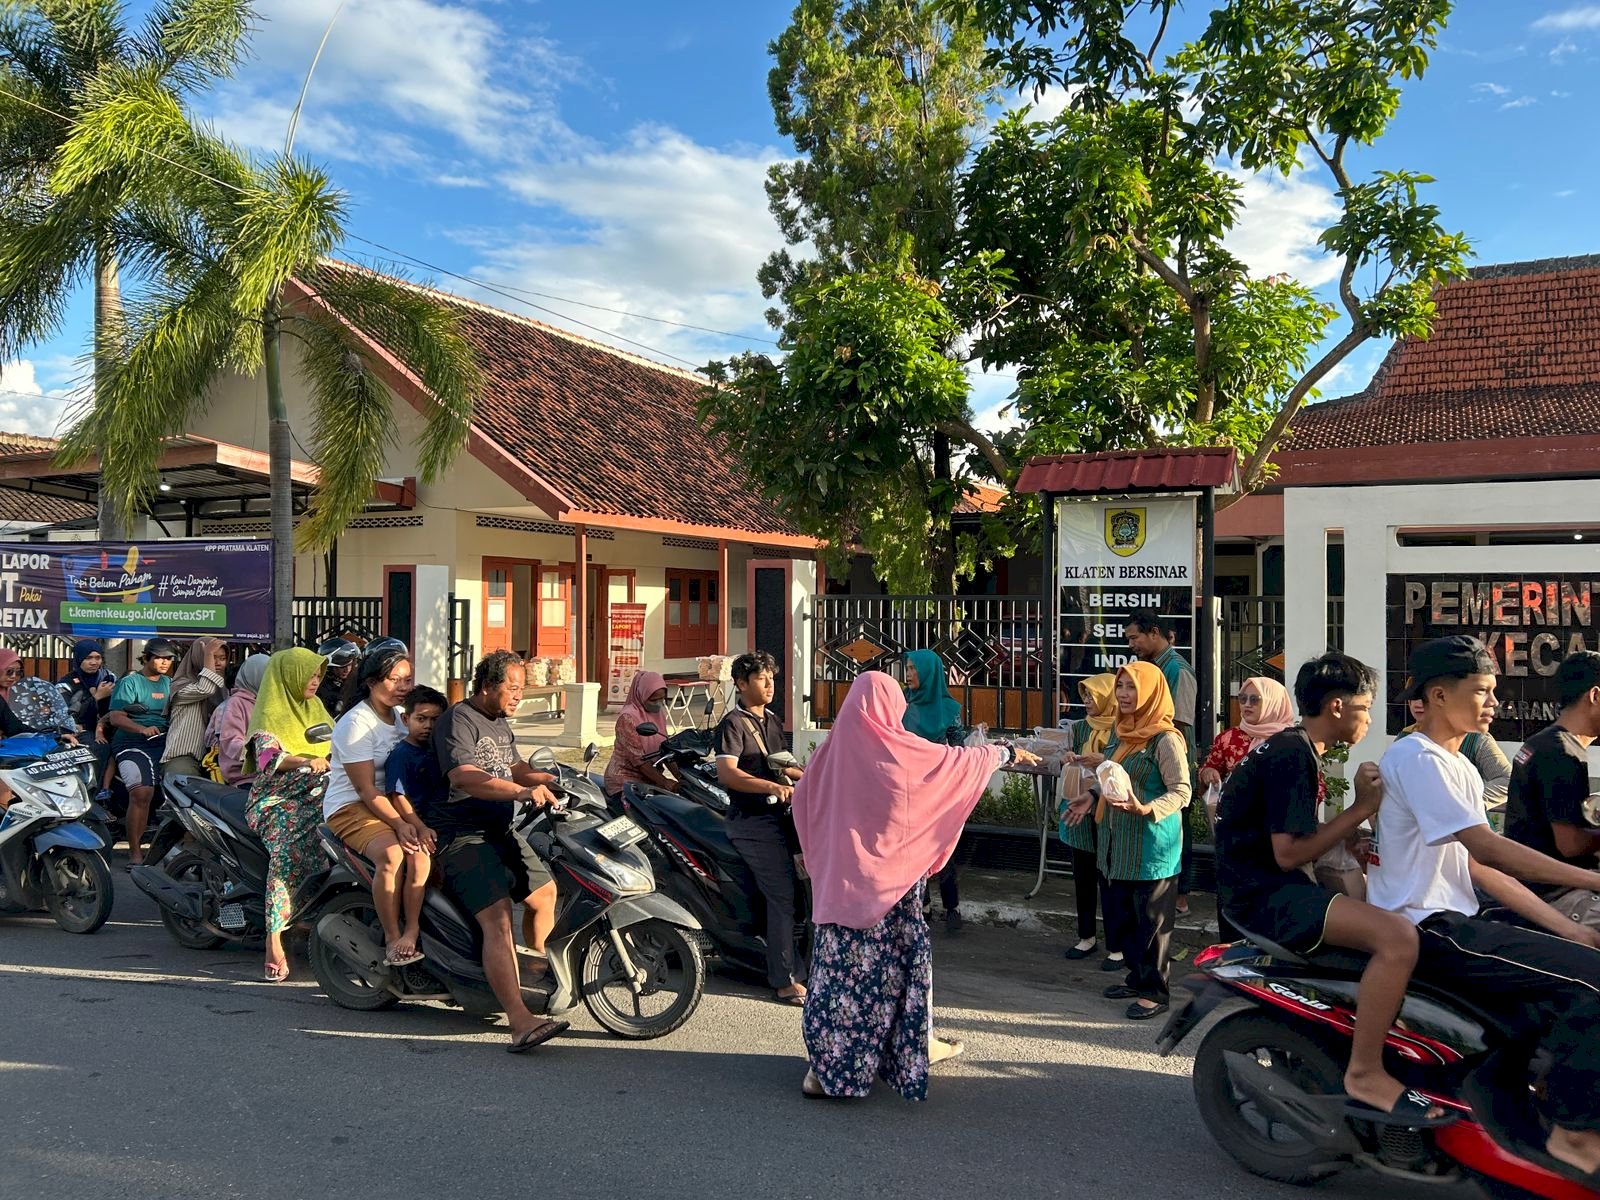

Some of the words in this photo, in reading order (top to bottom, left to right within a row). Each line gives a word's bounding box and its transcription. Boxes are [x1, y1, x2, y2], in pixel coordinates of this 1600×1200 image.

[205, 544, 217, 552] KPP
[218, 544, 246, 552] PRATAMA
[246, 544, 269, 552] KLATEN
[2, 553, 50, 570] LAPOR
[67, 574, 88, 589] Tapi
[89, 576, 117, 589] Belum
[119, 571, 153, 589] Paham
[1064, 566, 1116, 579] KLATEN
[1119, 565, 1188, 579] BERSINAR
[0, 572, 19, 603] T
[187, 574, 219, 588] Dampingi
[20, 586, 42, 603] Pakai
[172, 586, 196, 599] Sampai
[196, 586, 225, 598] Berhasil
[1089, 593, 1161, 608] BERSIH
[0, 608, 48, 629] ETAX
[69, 606, 216, 622] t.kemenkeu.go.id/coretaxSPT
[1092, 623, 1126, 638] SEH
[658, 833, 707, 877] VARIO
[1269, 983, 1332, 1010] Genio
